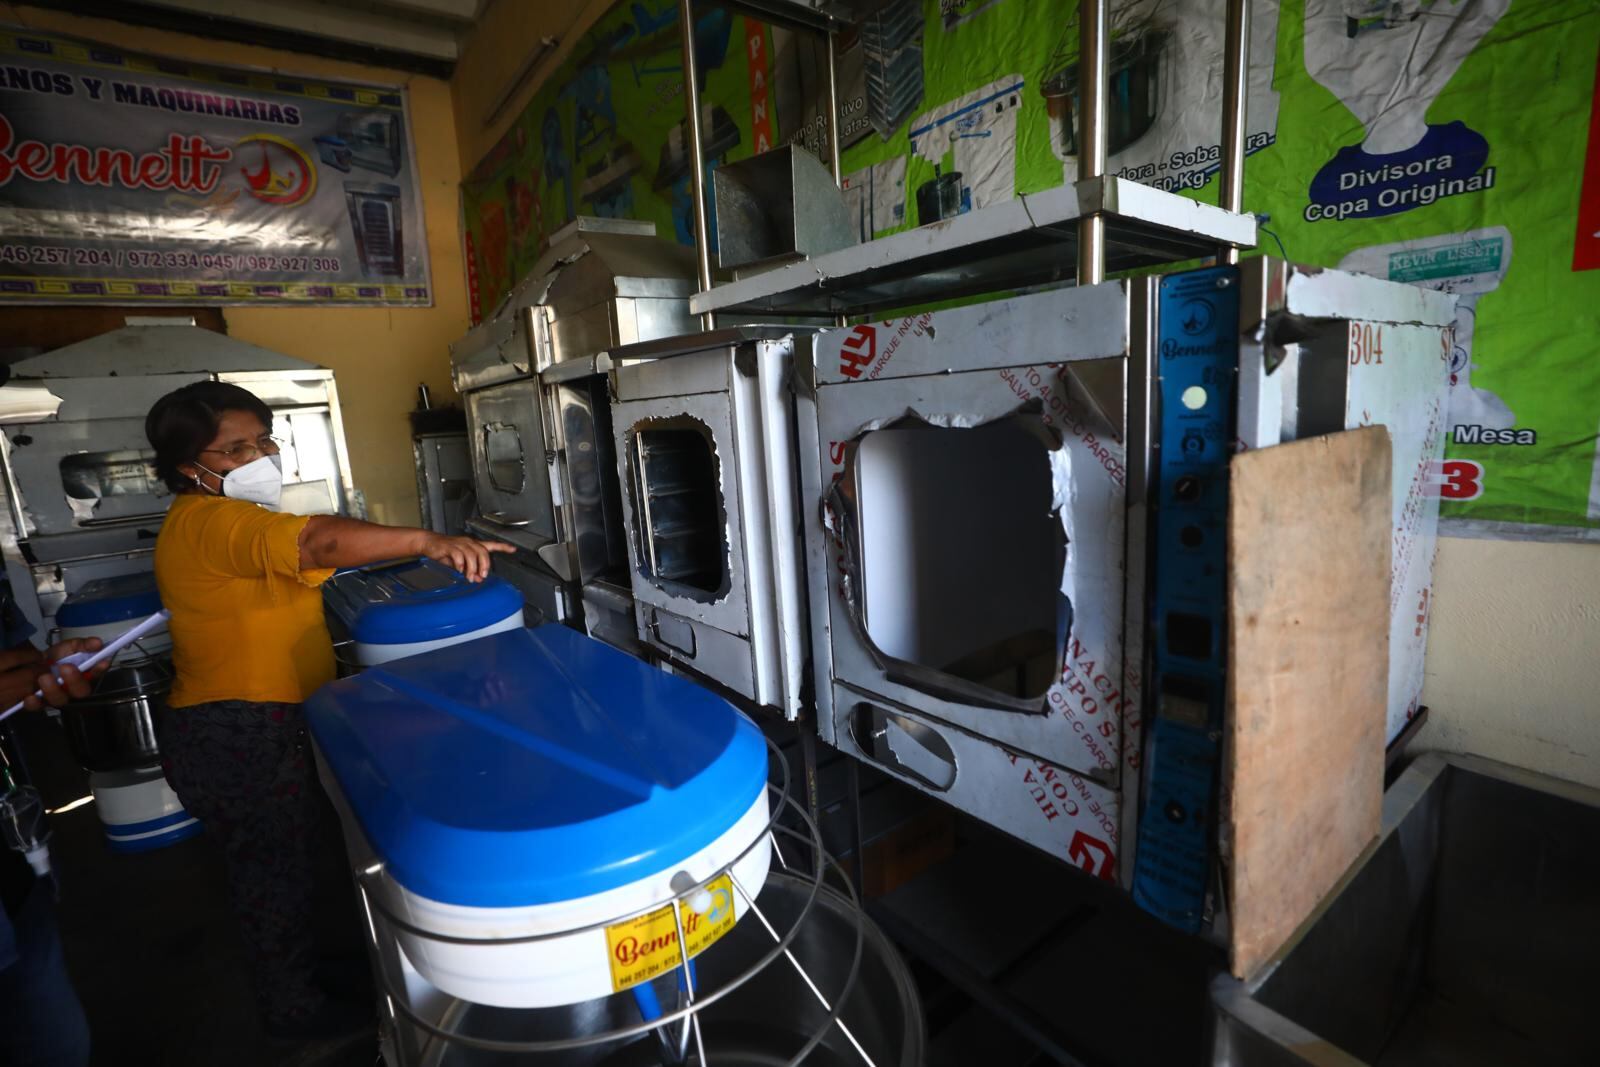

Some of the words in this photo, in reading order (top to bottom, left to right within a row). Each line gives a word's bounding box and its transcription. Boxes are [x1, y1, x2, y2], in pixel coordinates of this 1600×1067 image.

[81, 77, 102, 99] Y
[112, 82, 300, 125] MAQUINARIAS
[1113, 162, 1155, 182] dora
[1339, 154, 1452, 191] Divisora
[1305, 190, 1369, 222] Copa
[1378, 168, 1495, 207] Original
[0, 246, 28, 263] 46
[34, 248, 69, 264] 257
[76, 250, 111, 265] 204
[129, 252, 161, 267] 972
[167, 254, 198, 268] 334
[203, 254, 233, 269] 045
[313, 257, 340, 272] 308
[869, 334, 901, 380] PARQUE
[1349, 322, 1384, 366] 304
[1455, 425, 1536, 445] Mesa
[1024, 769, 1060, 821] HUA
[1032, 759, 1080, 817] COM
[1069, 772, 1092, 801] IND
[615, 911, 700, 967] Benntt
